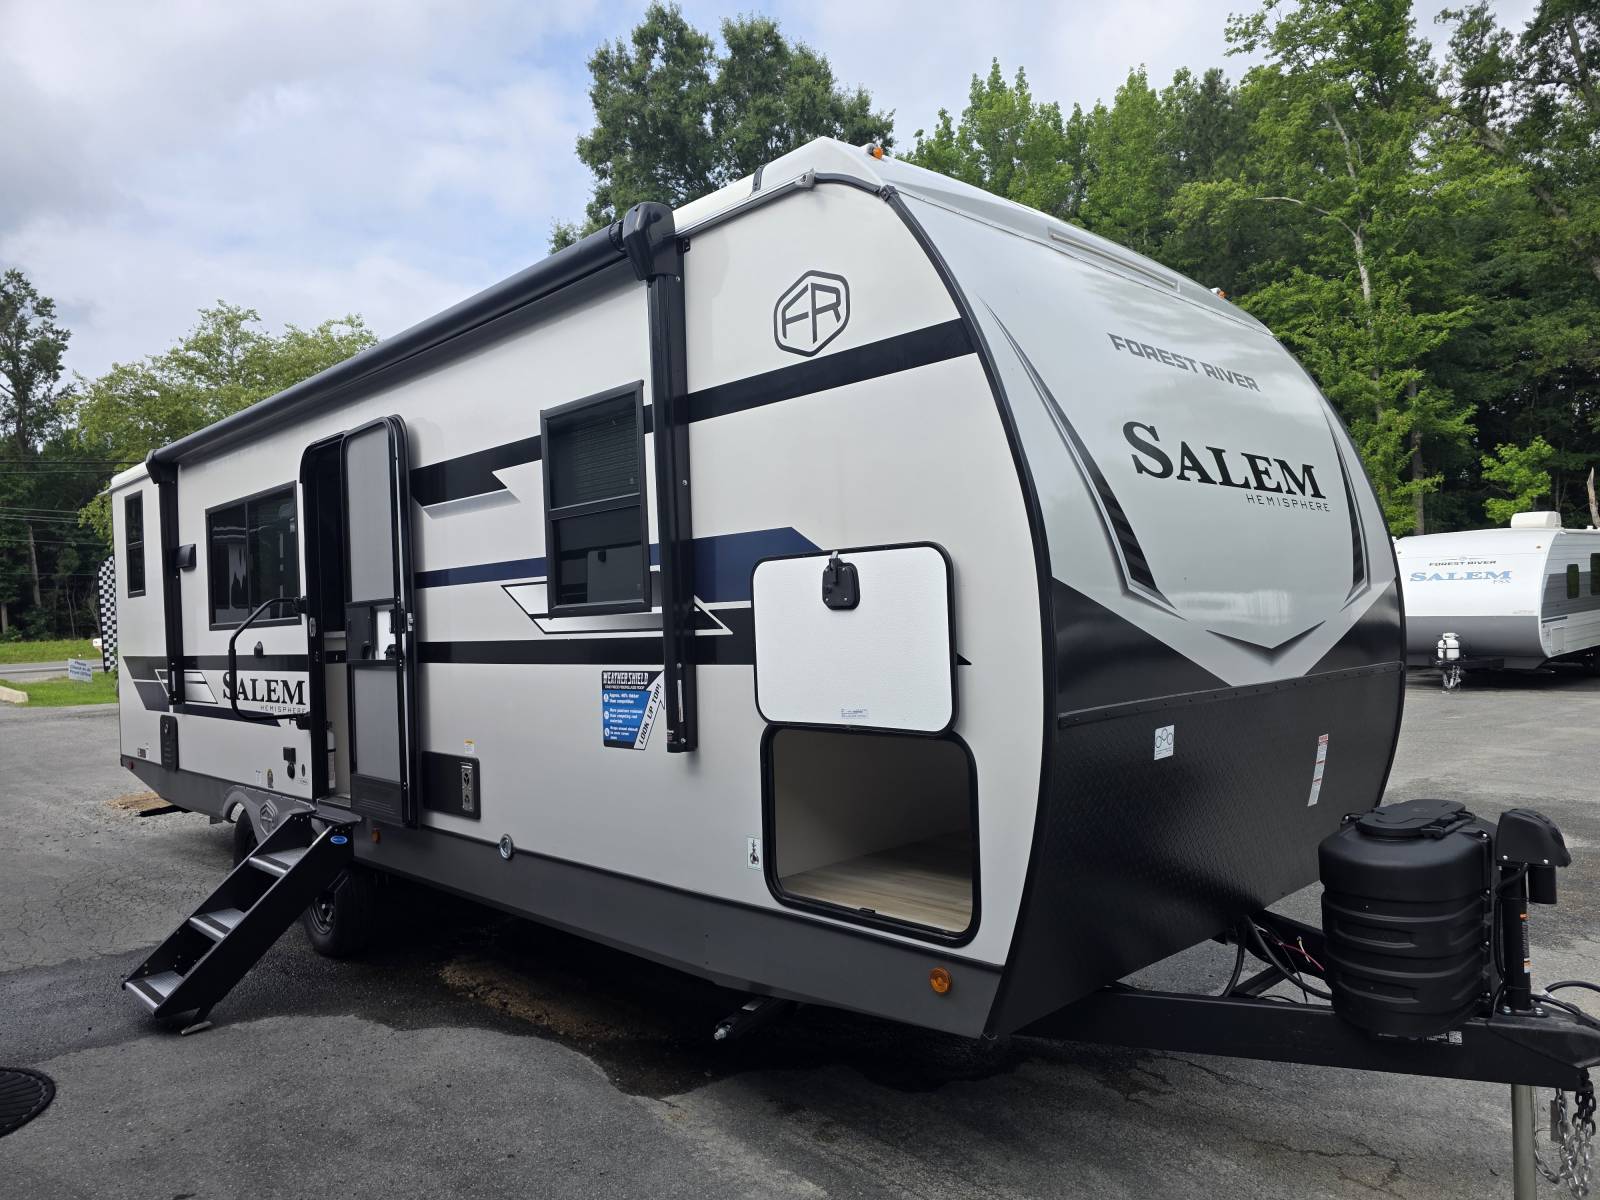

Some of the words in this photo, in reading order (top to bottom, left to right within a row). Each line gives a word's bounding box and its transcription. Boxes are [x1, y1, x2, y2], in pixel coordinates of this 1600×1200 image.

[1107, 332, 1198, 373] FOREST
[1202, 360, 1261, 393] RIVER
[1122, 420, 1327, 499] SALEM
[1245, 493, 1331, 513] HEMISPHERE
[1409, 570, 1513, 582] SALEM
[222, 671, 307, 706] SALEM
[628, 672, 649, 685] SHIELD
[638, 721, 650, 745] LOOK
[646, 706, 654, 720] UP
